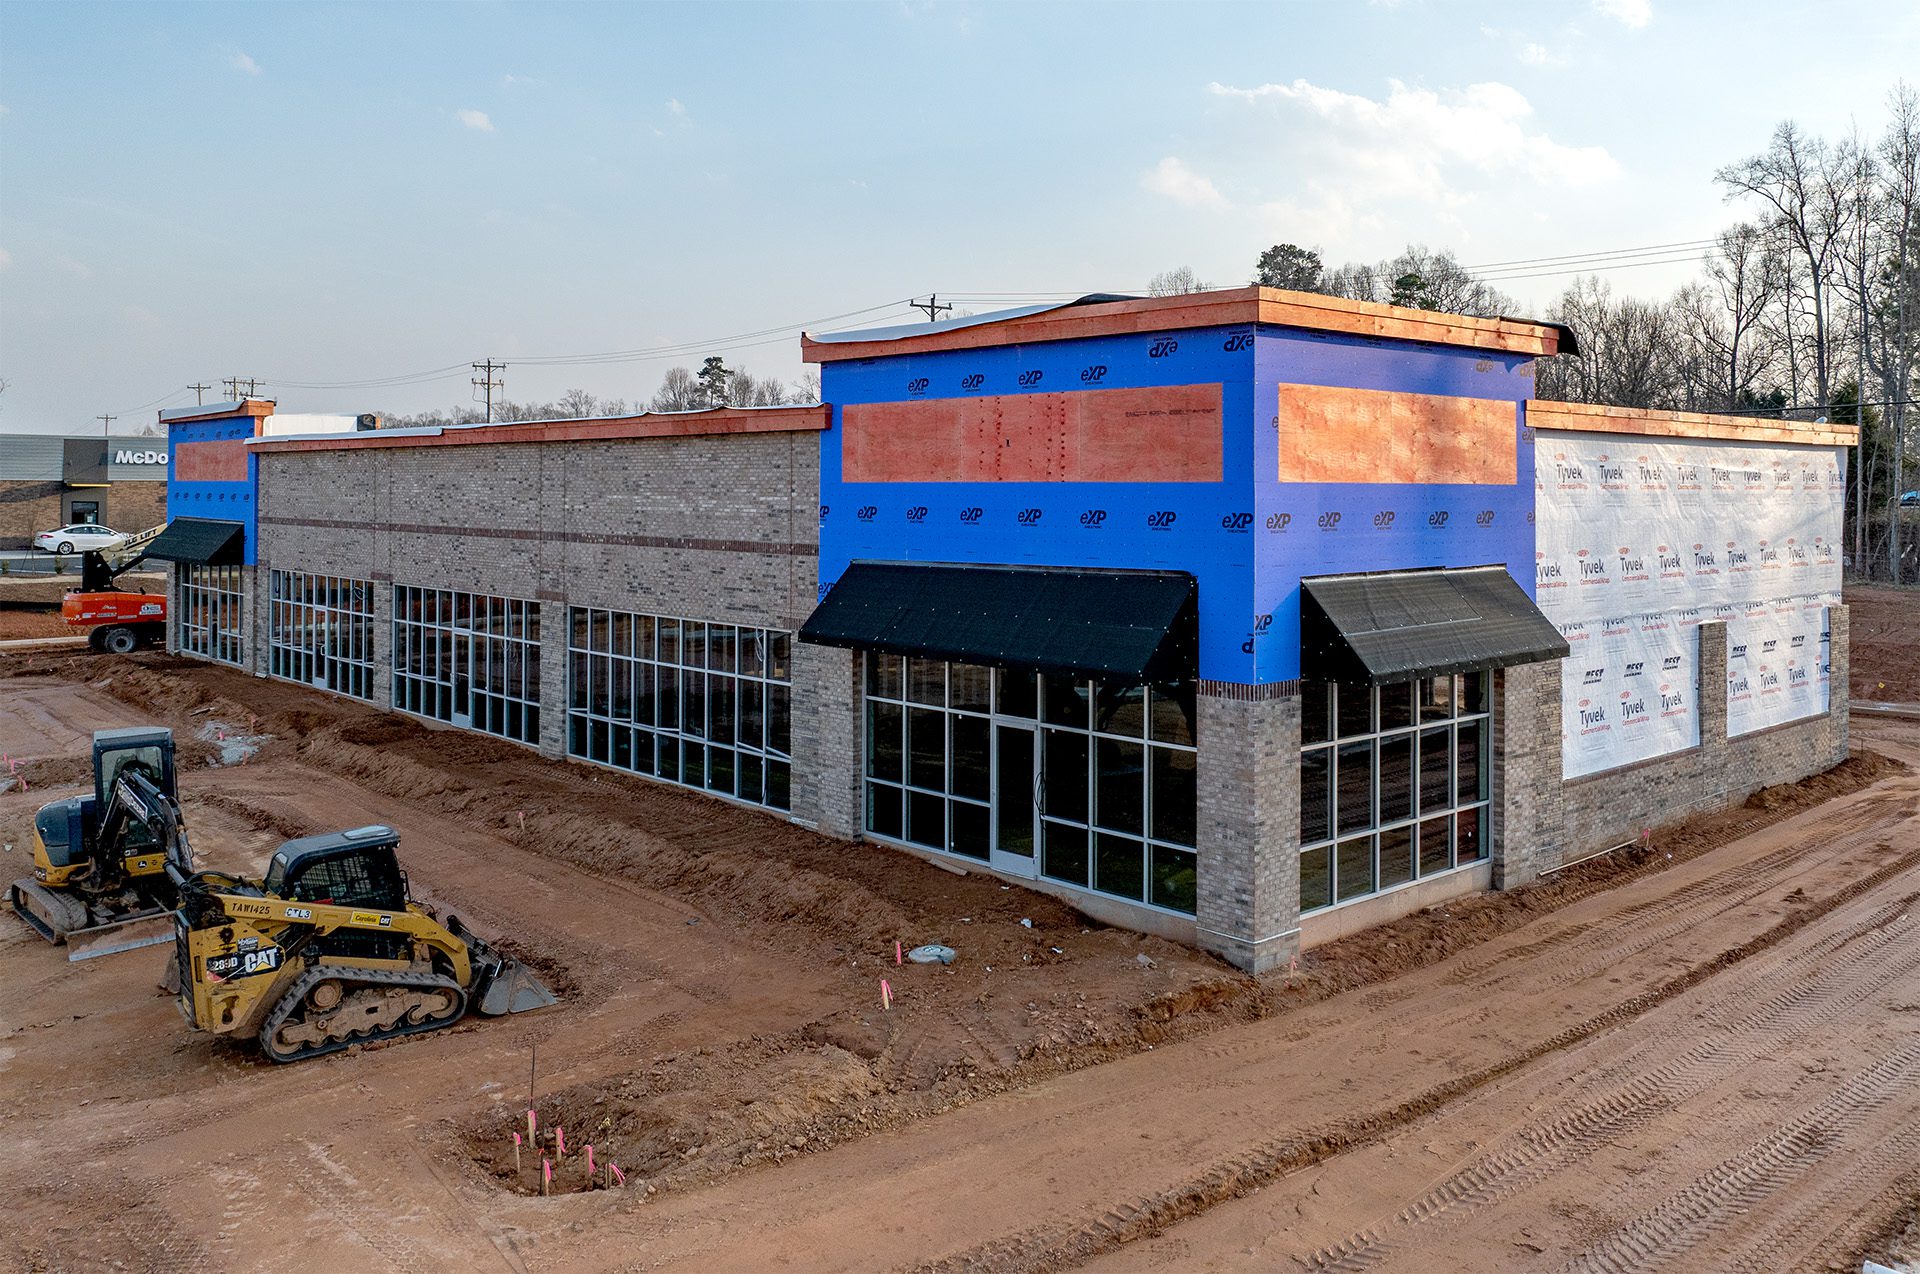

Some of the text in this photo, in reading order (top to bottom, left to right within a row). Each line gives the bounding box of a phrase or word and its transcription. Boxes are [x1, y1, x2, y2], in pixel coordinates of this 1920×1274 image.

[1018, 370, 1042, 386] eXP
[1081, 365, 1107, 381] eXP
[908, 378, 930, 393] eXP
[962, 374, 984, 389] eXP
[115, 450, 168, 465] McDo
[1557, 464, 1583, 483] Tyvek
[1599, 464, 1623, 483] Tyvek
[1640, 465, 1663, 483] Tyvek
[1678, 466, 1698, 484] Tyvek
[857, 506, 877, 519] eXP
[906, 506, 928, 520] eXP
[960, 507, 983, 521] eXP
[1018, 508, 1042, 523] eXP
[1080, 509, 1107, 524] eXP
[1148, 511, 1176, 526] eXP
[1222, 512, 1253, 528] eXP
[1318, 511, 1341, 527] eXP
[1374, 511, 1395, 526] eXP
[1429, 511, 1448, 526] eXP
[1476, 510, 1495, 525] eXP
[1266, 513, 1291, 529] eXP
[1620, 557, 1644, 574] Tyvek
[1659, 554, 1681, 572] Tyvek
[1694, 552, 1715, 568] Tyvek
[1728, 549, 1747, 567] Tyvek
[1536, 562, 1562, 582] Tyvek
[1579, 558, 1605, 579] Tyvek
[1255, 614, 1273, 631] XP
[1729, 677, 1749, 696] Tyvek
[1621, 698, 1645, 719] Tyvek
[1661, 691, 1682, 710] Tyvek
[1580, 706, 1605, 727] Tyvek
[287, 908, 311, 918] CTL3
[245, 948, 278, 973] CAT
